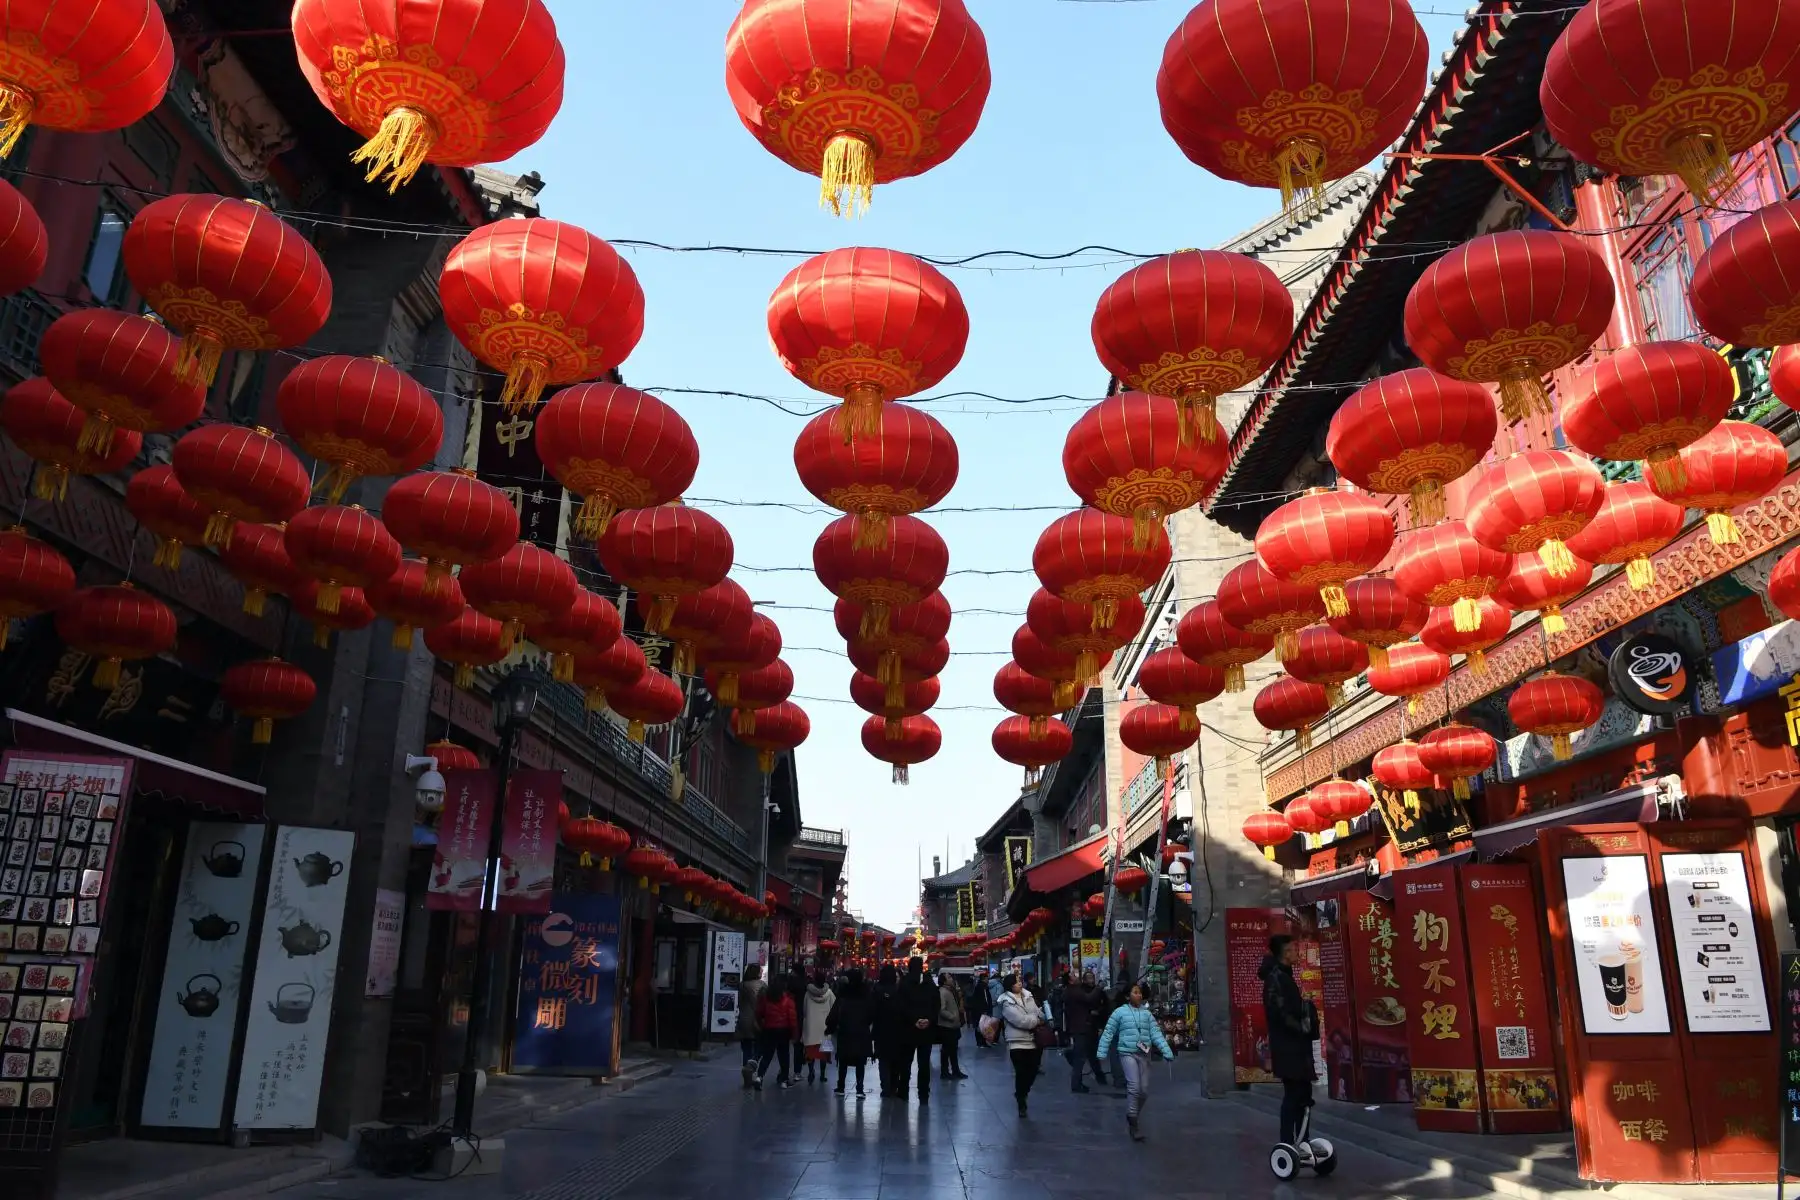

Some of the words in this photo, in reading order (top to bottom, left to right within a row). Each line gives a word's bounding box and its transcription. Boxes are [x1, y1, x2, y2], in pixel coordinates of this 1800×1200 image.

[1412, 909, 1461, 1041] 狗不理
[1612, 1080, 1662, 1103] 咖啡
[1619, 1117, 1669, 1142] 西餐
